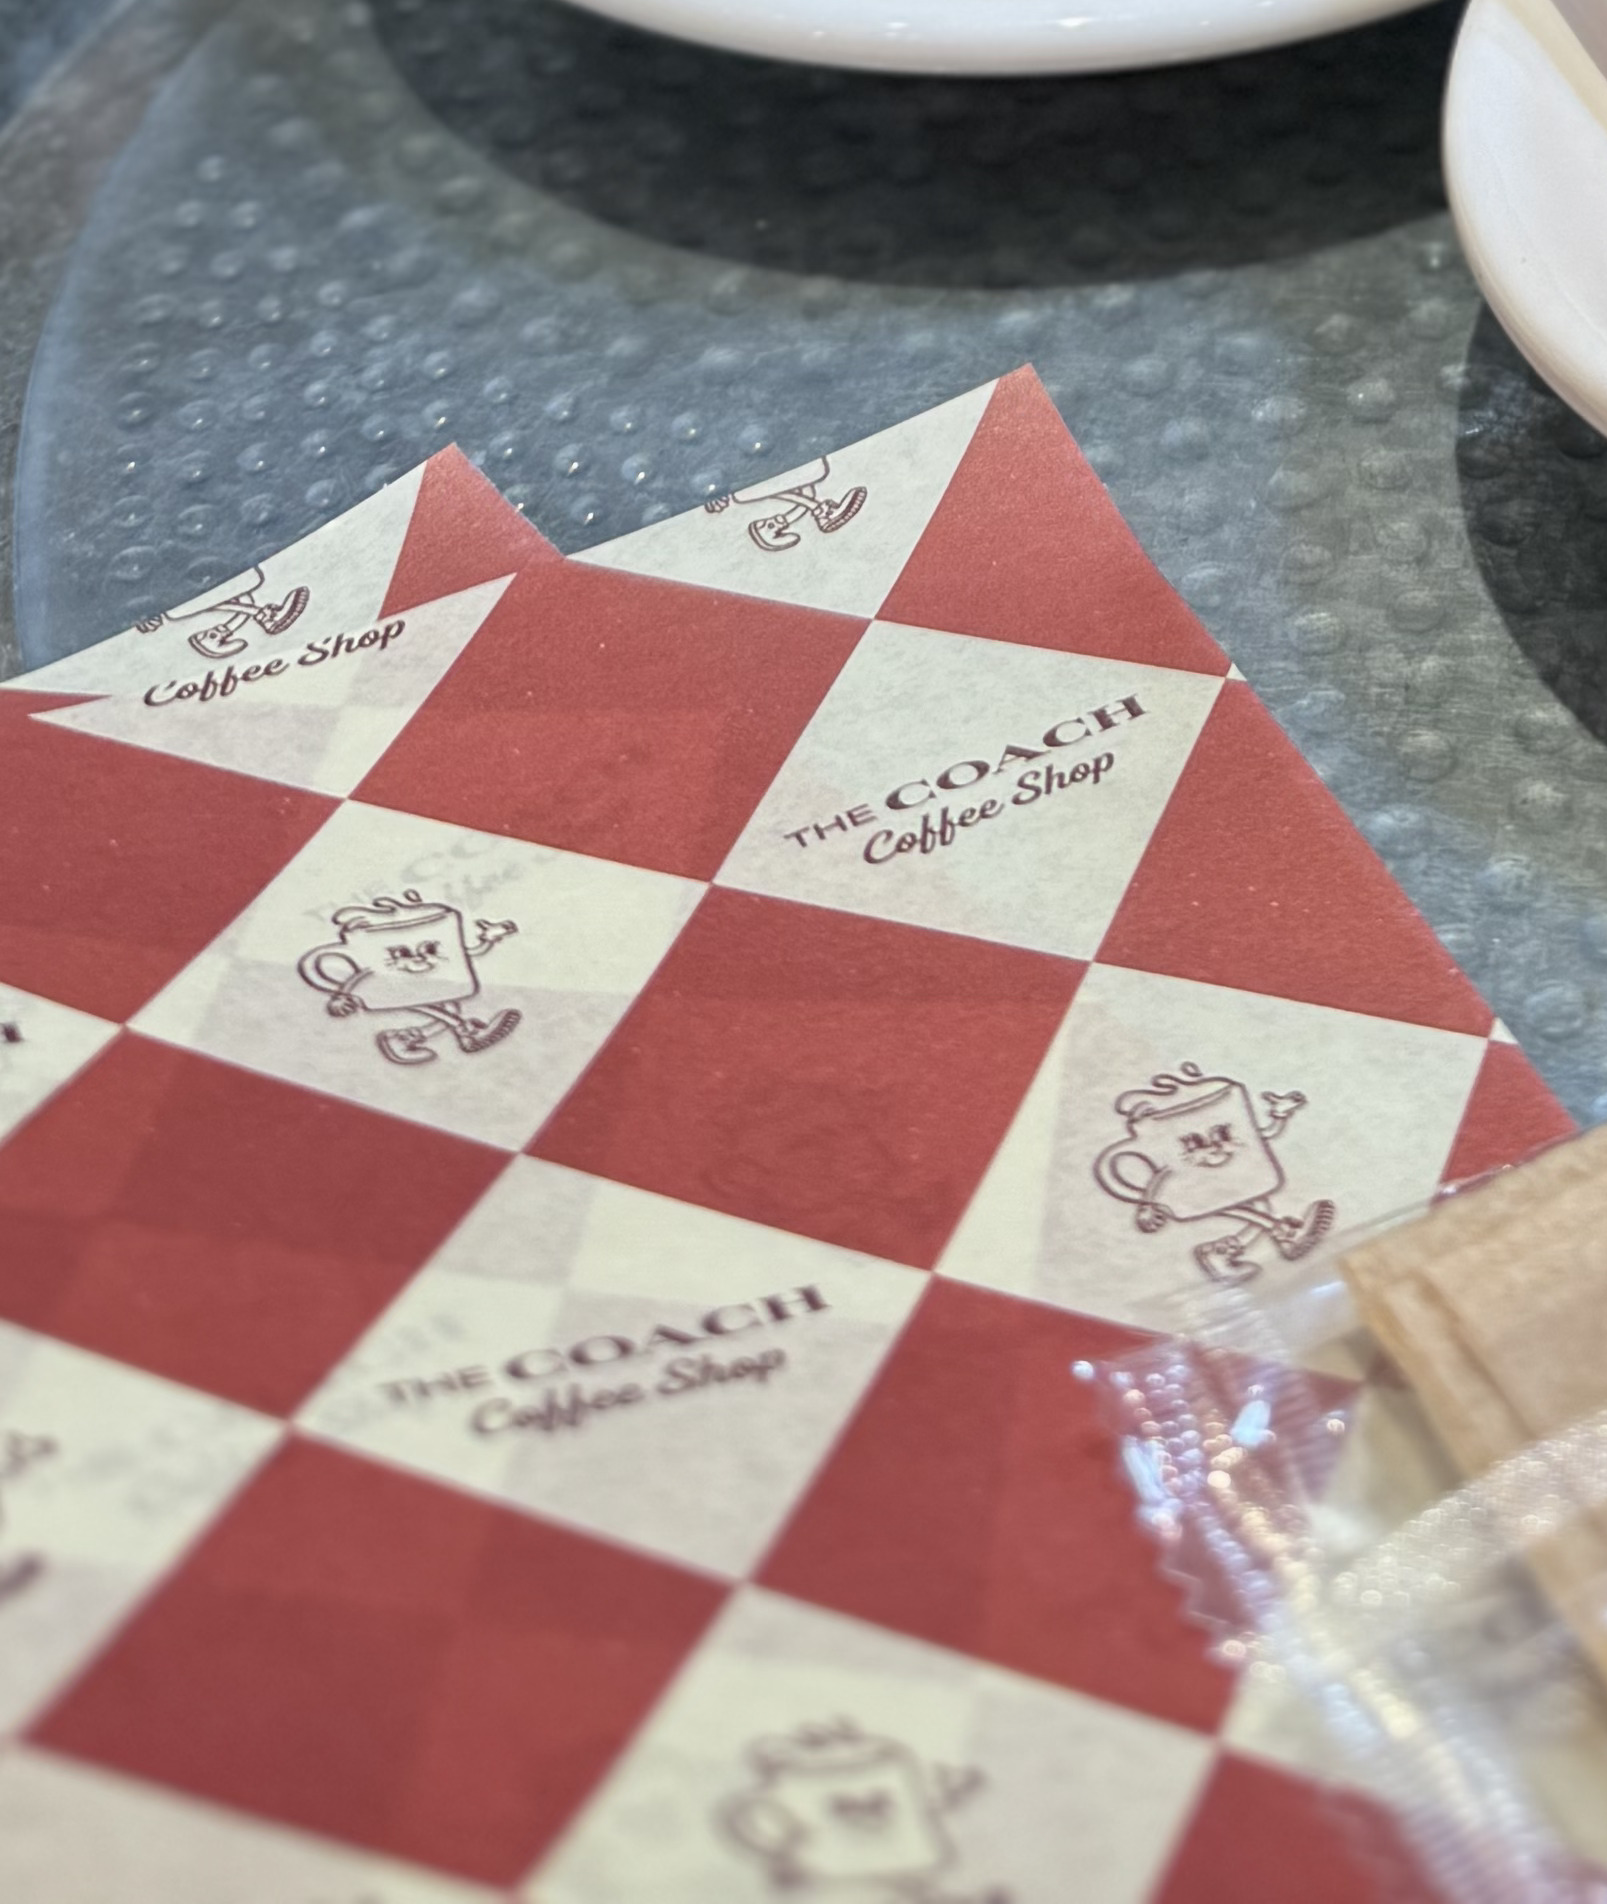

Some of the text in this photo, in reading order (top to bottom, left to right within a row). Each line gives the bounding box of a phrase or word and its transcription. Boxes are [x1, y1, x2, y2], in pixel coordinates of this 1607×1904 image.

[143, 617, 407, 708] Coffee Shop
[783, 694, 1149, 849] THE COACH
[862, 748, 1116, 865] Coffee Shop
[378, 1284, 832, 1406] THE COACH
[468, 1346, 787, 1438] Coffee Shop
